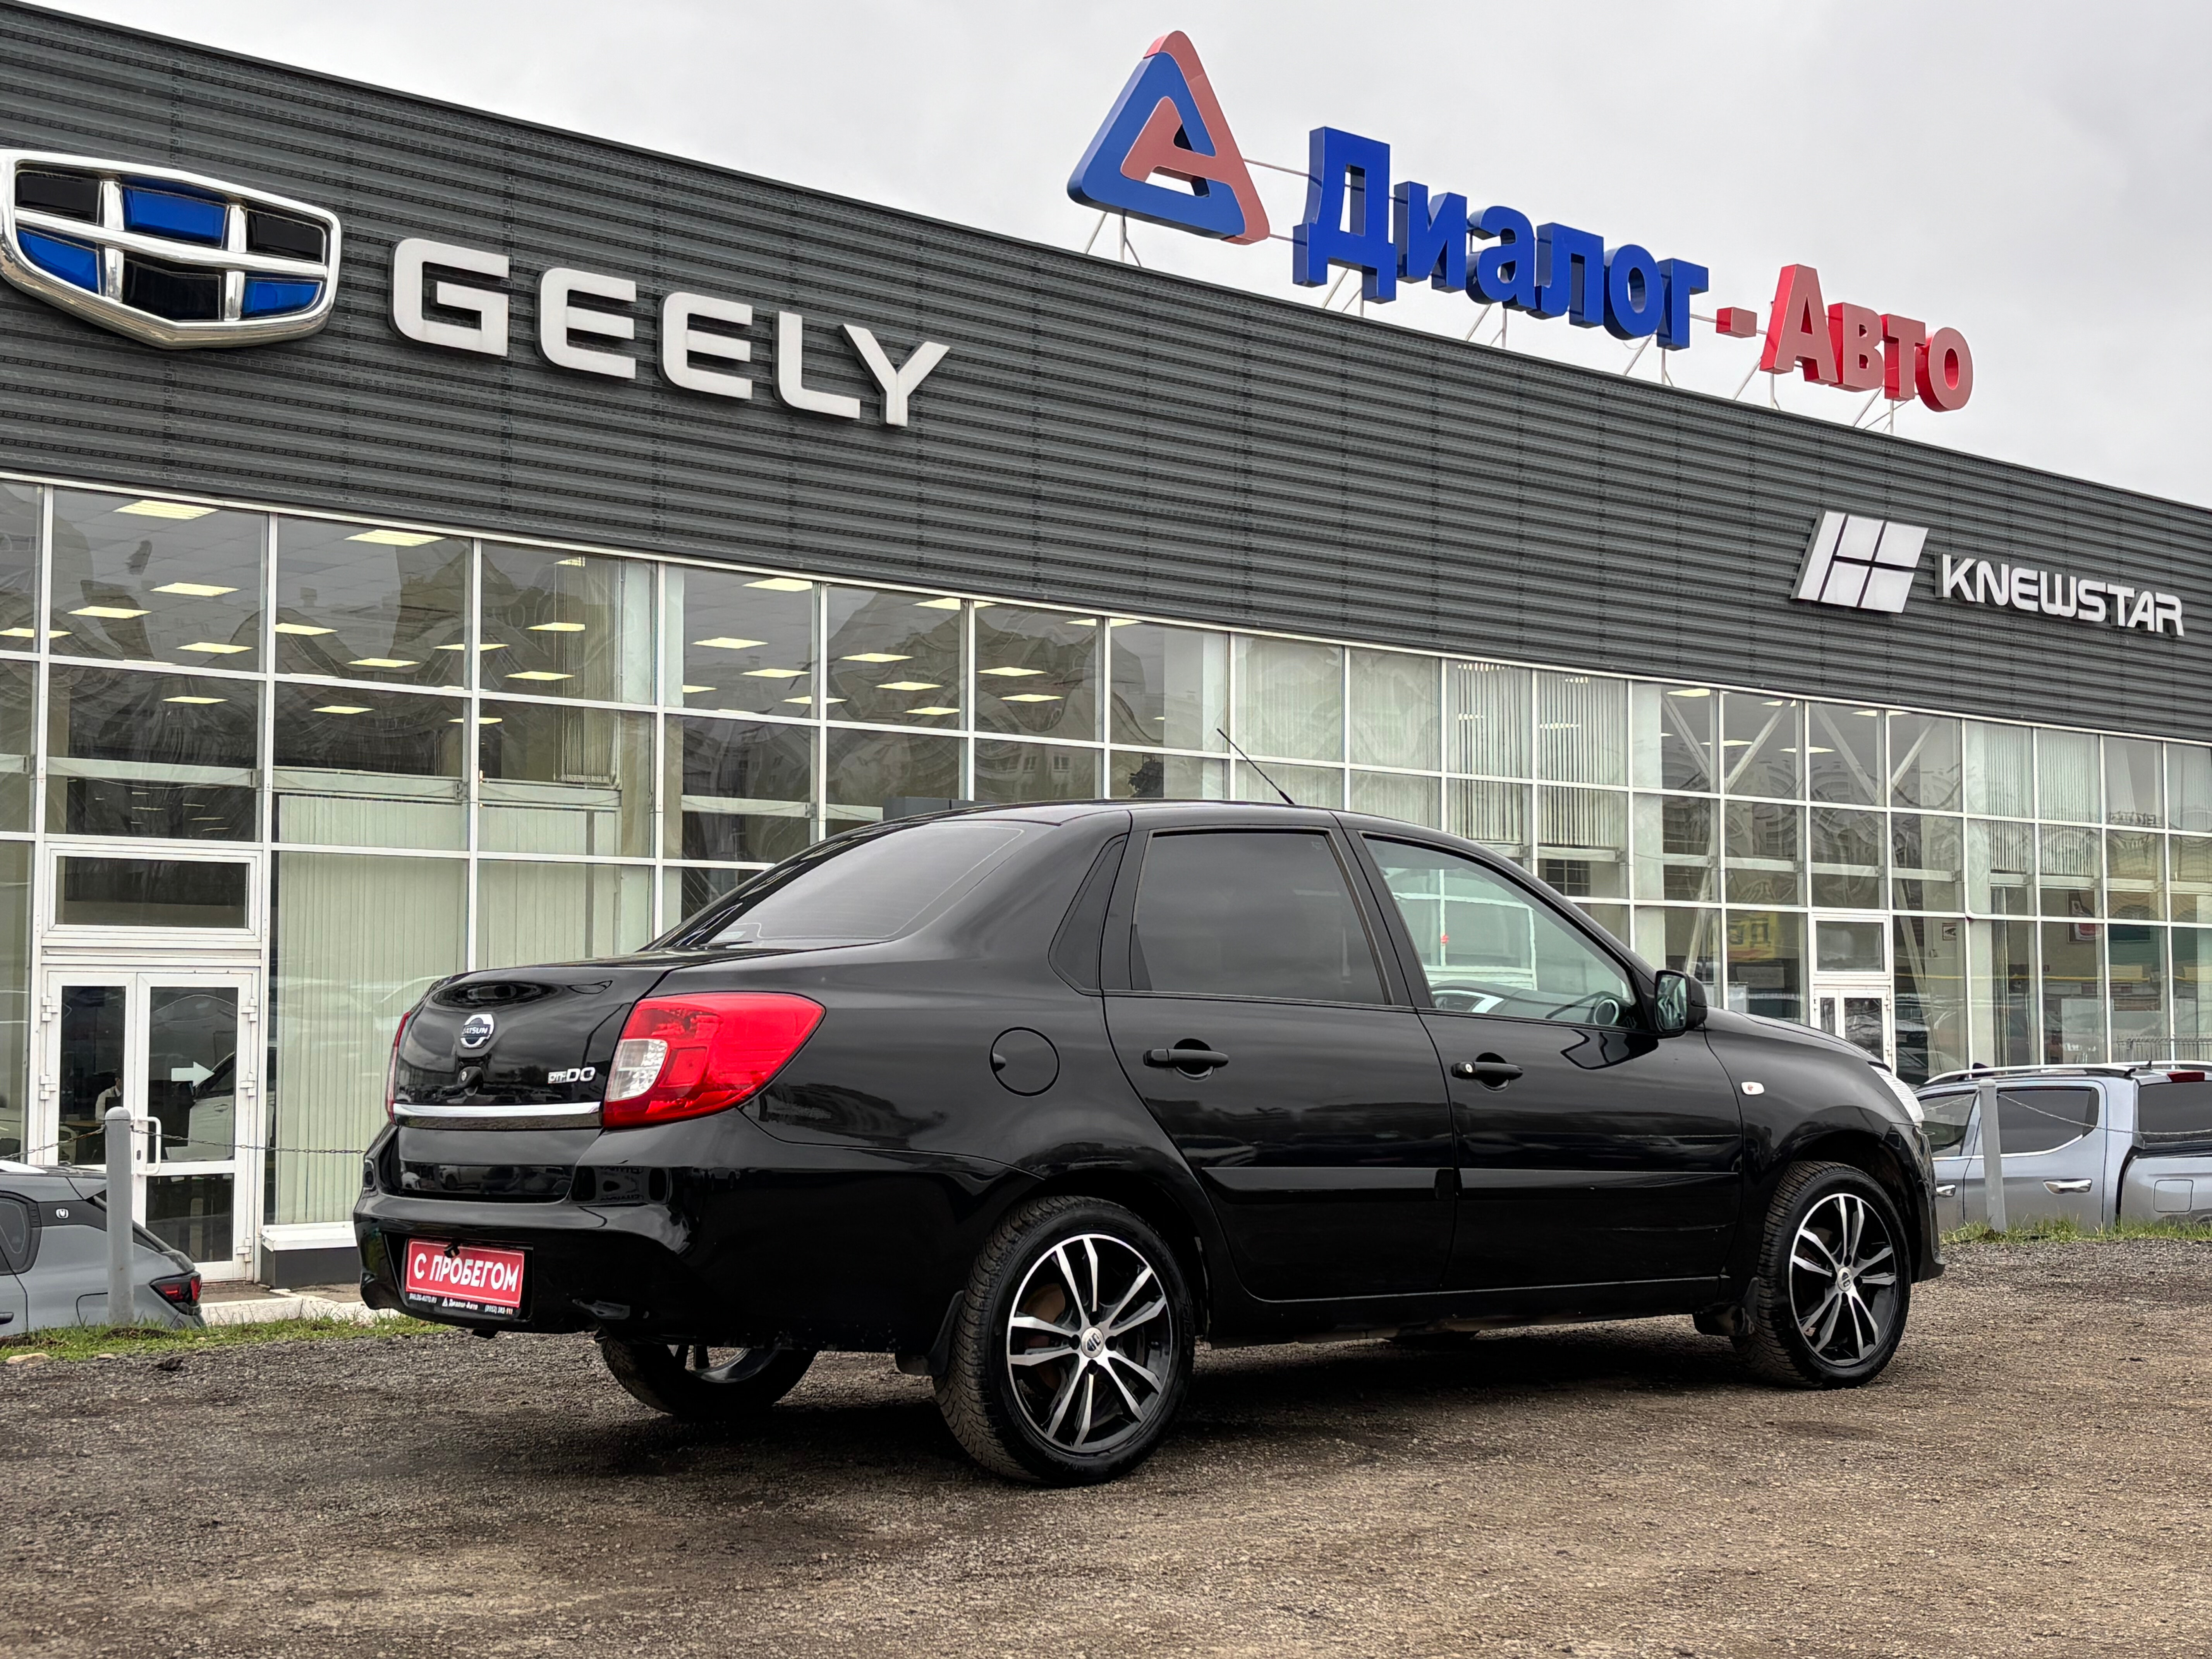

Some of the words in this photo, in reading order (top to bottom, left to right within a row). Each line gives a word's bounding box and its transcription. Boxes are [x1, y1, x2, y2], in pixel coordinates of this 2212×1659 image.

[389, 237, 951, 427] GEELY
[1936, 554, 2184, 637] KNEWSTAR
[414, 1253, 427, 1279] С
[429, 1255, 519, 1292] ПРОБЕГОМ
